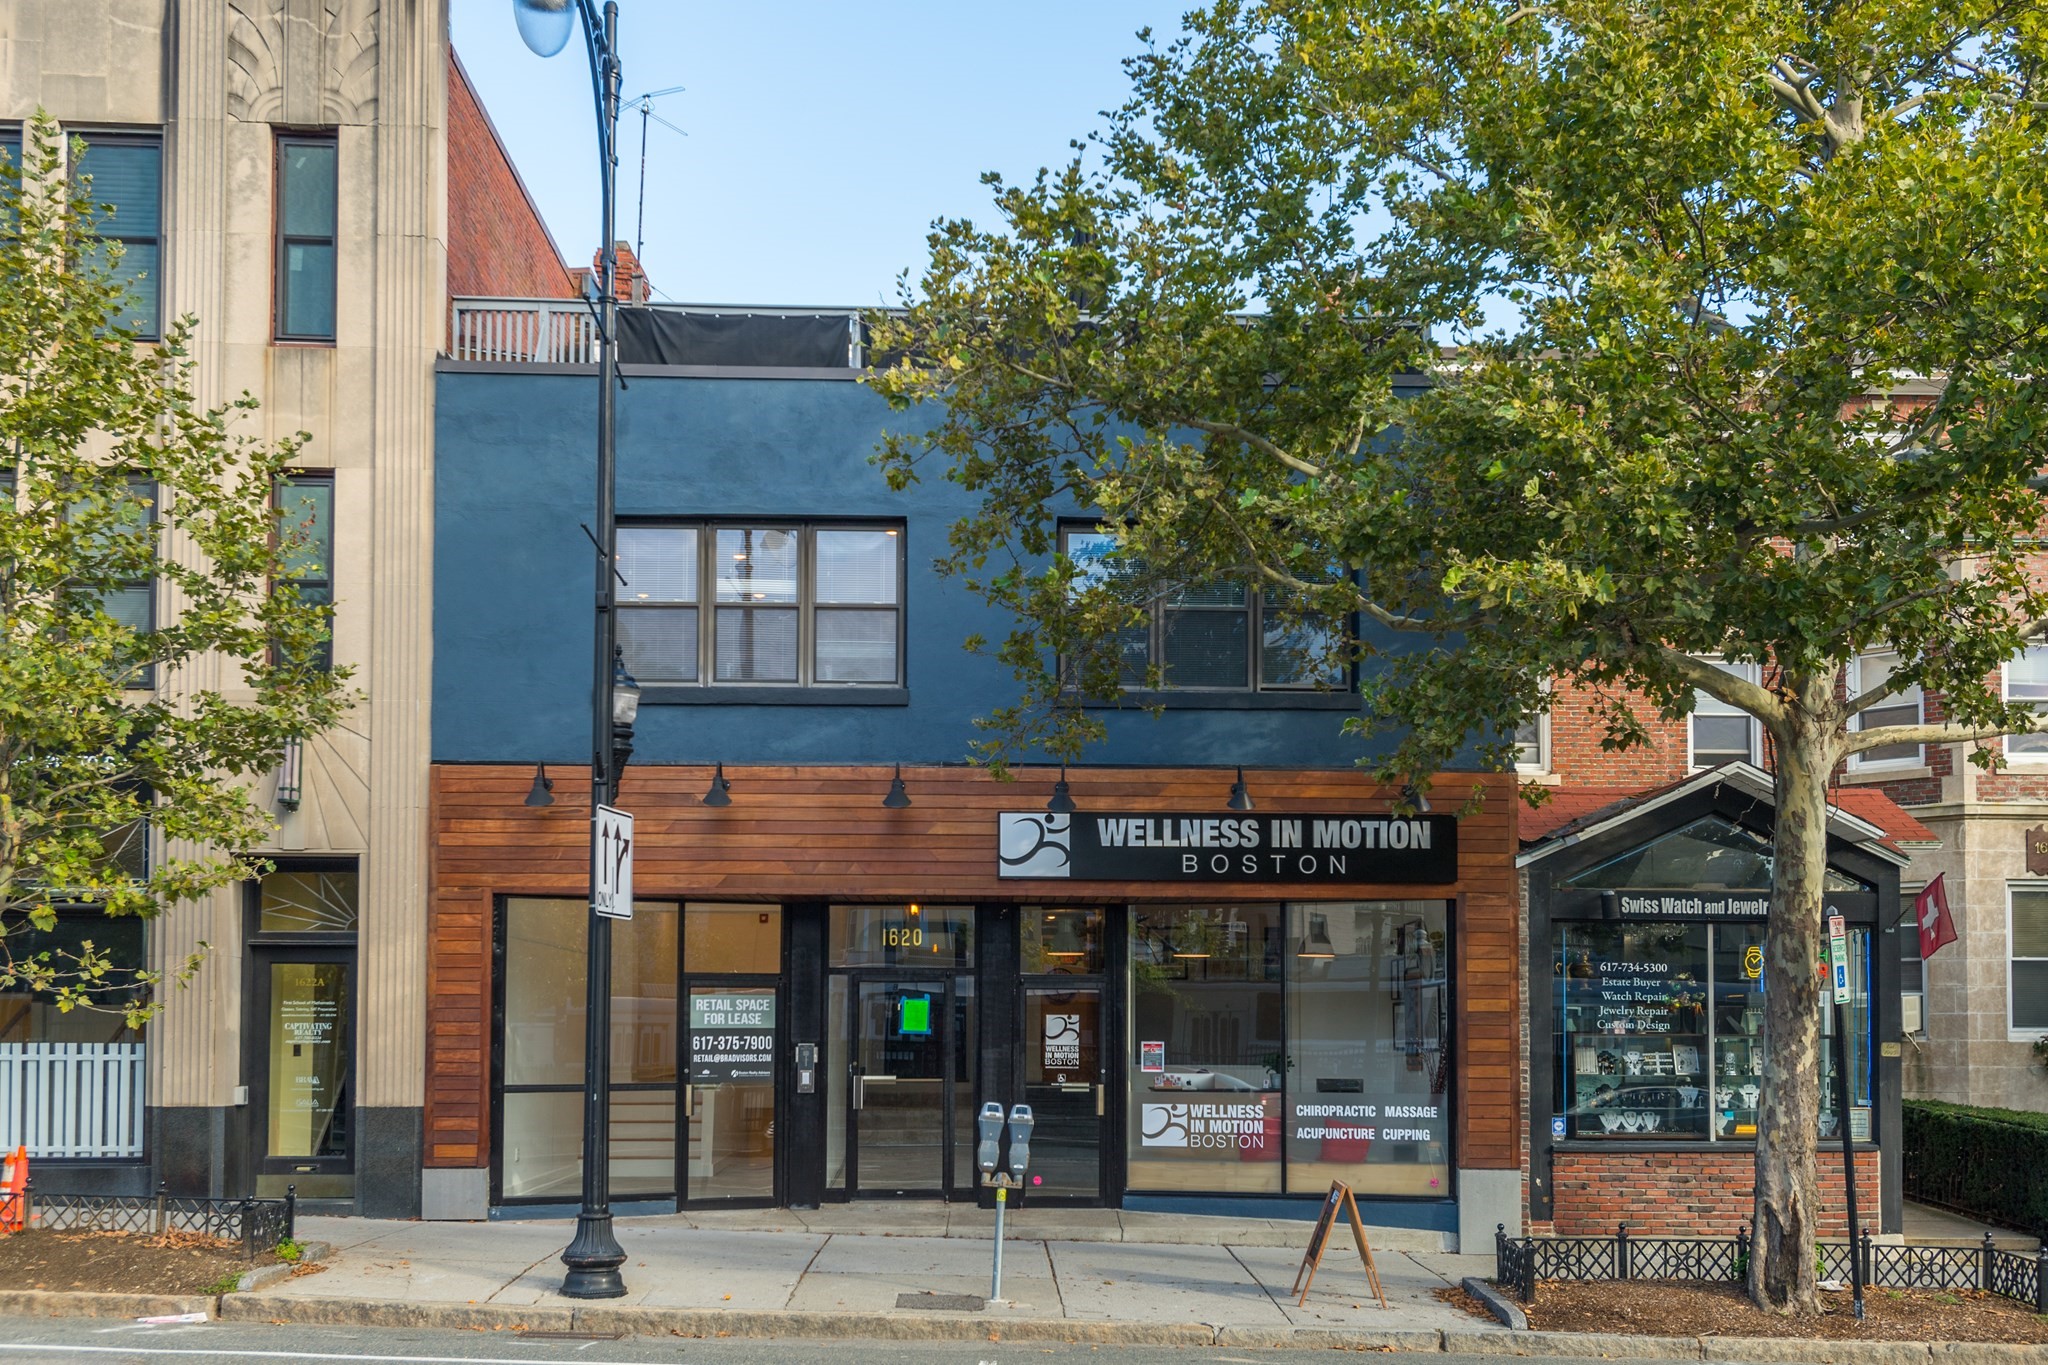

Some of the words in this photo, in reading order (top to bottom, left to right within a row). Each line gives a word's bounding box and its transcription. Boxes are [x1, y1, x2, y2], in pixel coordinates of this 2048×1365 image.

[1097, 818, 1260, 848] WELLNESS
[1271, 819, 1303, 849] IN
[1312, 820, 1432, 850] MOTION
[1182, 854, 1347, 875] BOSTON
[1621, 896, 1660, 914] Swiss
[1661, 897, 1703, 915] Watch
[1704, 900, 1725, 915] and
[1726, 898, 1769, 915] Jewelr
[882, 928, 923, 946] 1620
[1599, 961, 1669, 973] 617-734-5300
[295, 977, 325, 987] 1622A
[1602, 977, 1632, 987] Estate
[1633, 977, 1662, 990] Buyer
[1601, 991, 1632, 1001] Watch
[1634, 991, 1667, 1004] Repair
[695, 999, 734, 1011] RETAIL
[735, 999, 770, 1011] SPACE
[1598, 1005, 1635, 1018] Jewelry
[1636, 1005, 1669, 1018] Repair
[284, 1022, 333, 1030] CAPTIVATING
[703, 1013, 725, 1025] FOR
[727, 1013, 762, 1025] LEASE
[1596, 1019, 1635, 1029] Custom
[1637, 1019, 1670, 1033] Design
[692, 1035, 773, 1050] 617-375-7900
[693, 1053, 772, 1063] RETAIL@BRADVISORS.COM
[1045, 1058, 1079, 1066] BOSTON
[1189, 1104, 1264, 1119] WELLNESS
[1296, 1104, 1377, 1117] CHIROPRACTIC
[1384, 1106, 1438, 1118] MASSAGE
[1190, 1119, 1205, 1133] IN
[1209, 1120, 1264, 1134] MOTION
[1296, 1127, 1376, 1140] ACUPUNCTURE
[1382, 1128, 1431, 1141] CUPPING
[1190, 1134, 1264, 1149] BOSTON
